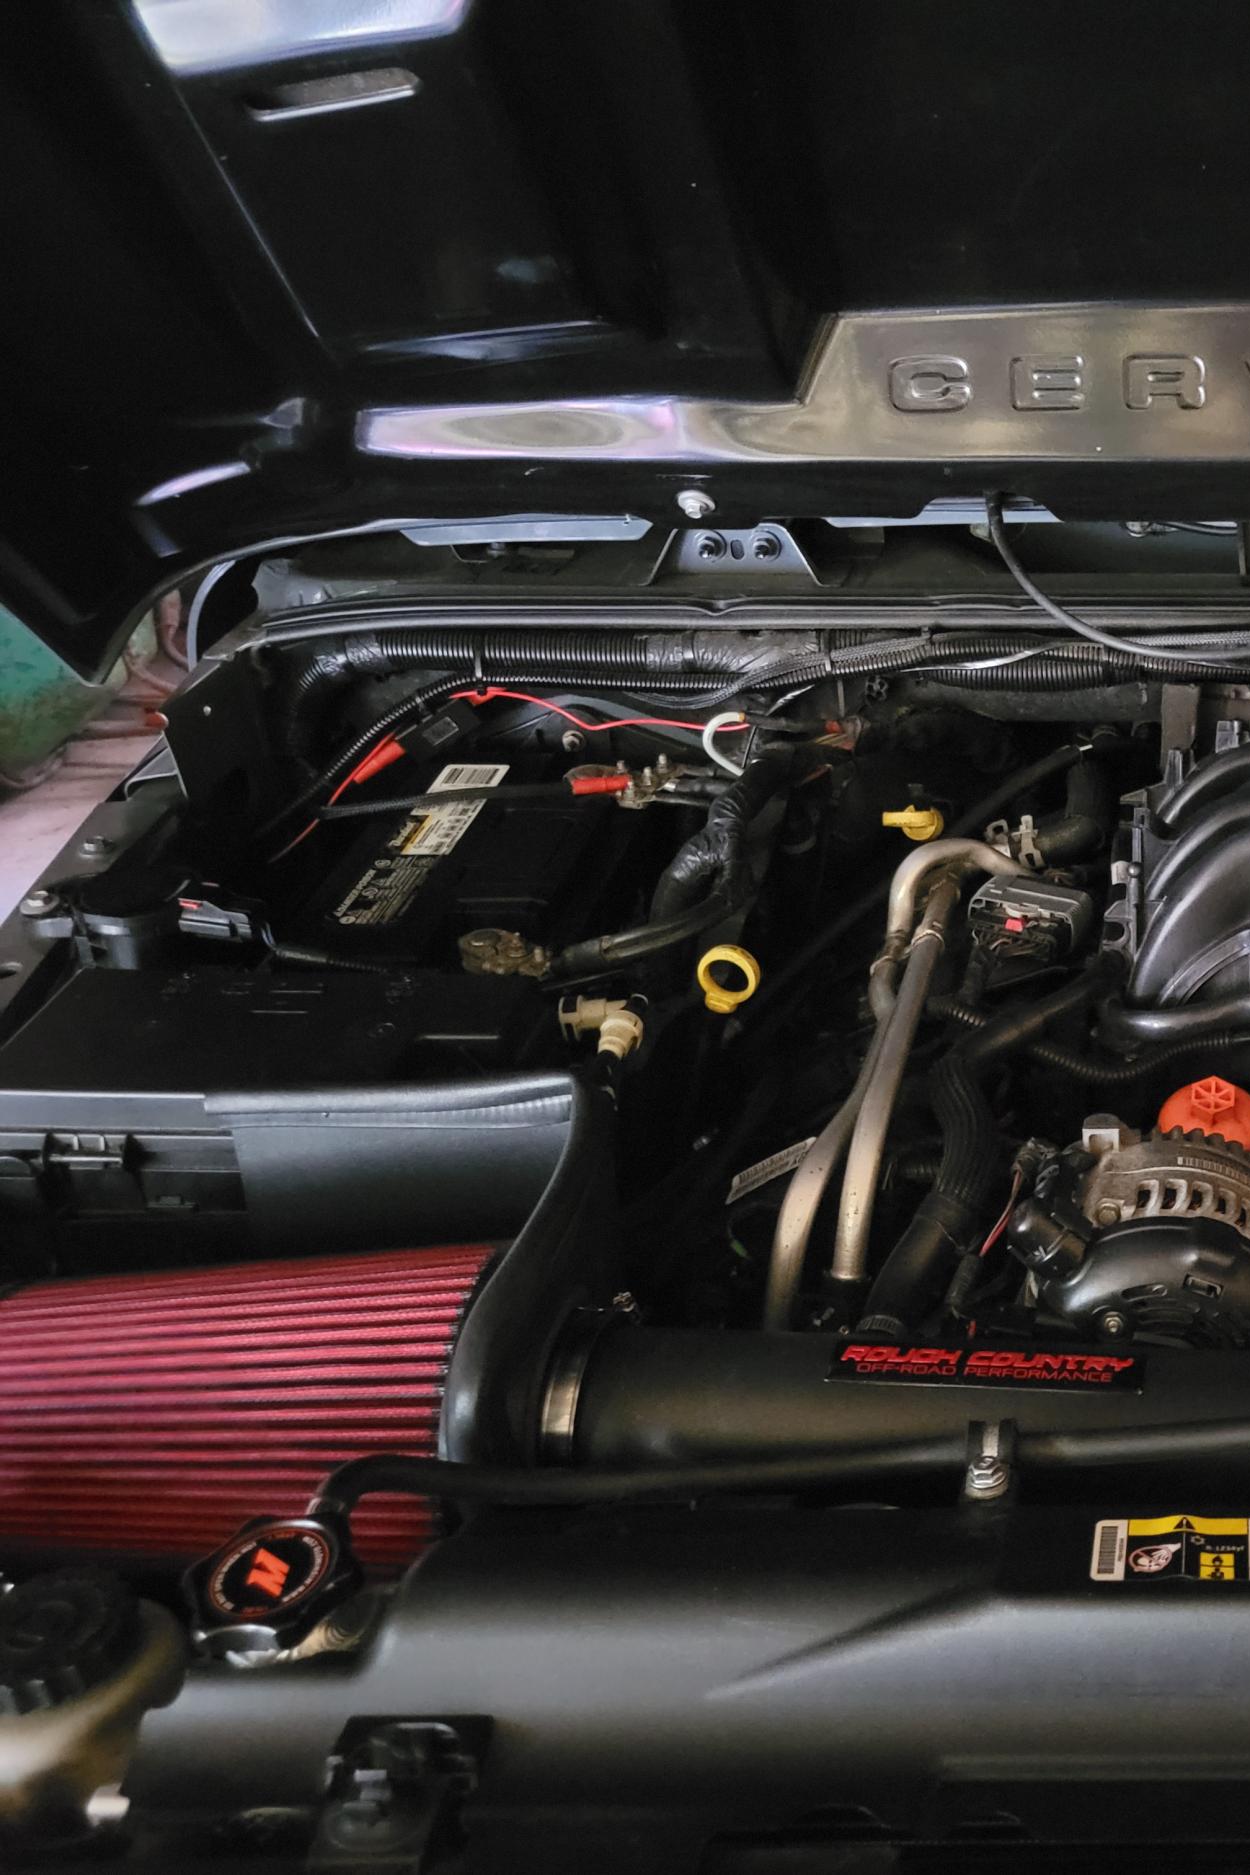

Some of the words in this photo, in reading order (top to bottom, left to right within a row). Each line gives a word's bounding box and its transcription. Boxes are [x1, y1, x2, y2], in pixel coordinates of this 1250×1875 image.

[841, 1345, 963, 1365] ROUGH
[967, 1350, 1135, 1372] COUNTRY
[856, 1362, 957, 1376] OFF-ROAD
[963, 1366, 1113, 1383] PERFORMANCE
